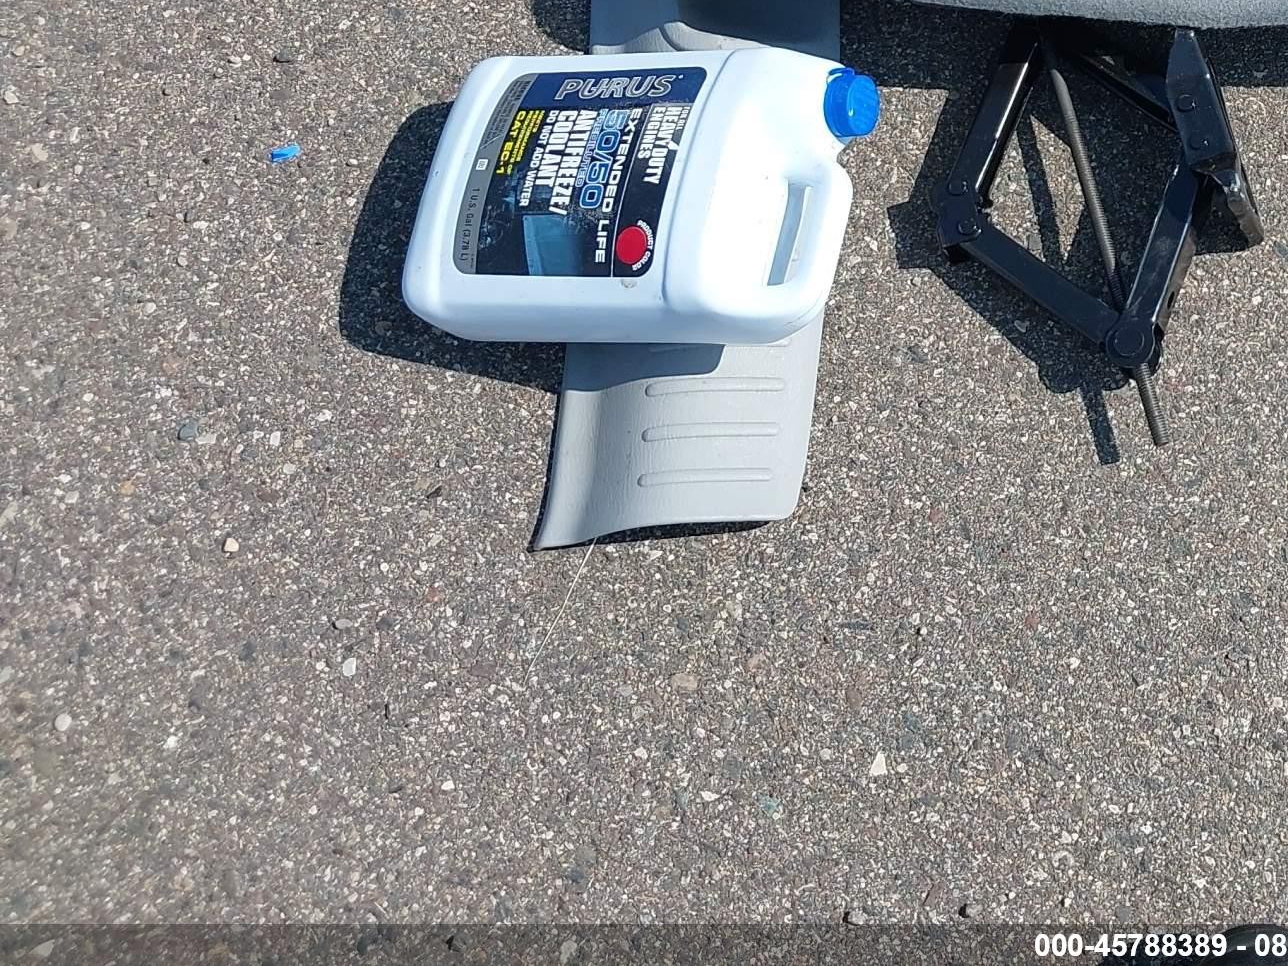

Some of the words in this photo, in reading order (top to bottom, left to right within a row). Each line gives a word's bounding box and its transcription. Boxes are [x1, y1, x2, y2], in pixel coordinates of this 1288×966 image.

[554, 75, 676, 100] PURUS
[510, 111, 526, 137] CAT
[546, 110, 560, 123] DO
[637, 106, 666, 159] ENGINES
[655, 107, 682, 147] HEAVY
[534, 109, 579, 188] COOLANT
[537, 125, 552, 145] NOT
[530, 147, 544, 168] ADD
[548, 109, 598, 216] ANTIFREEZE/
[579, 109, 629, 209] 50/50
[601, 108, 643, 213] EXTENDED
[643, 148, 668, 184] DUTY
[519, 170, 538, 207] WATER
[595, 219, 610, 263] LIFE
[637, 219, 654, 250] PRODUCT
[632, 250, 651, 271] COLOR
